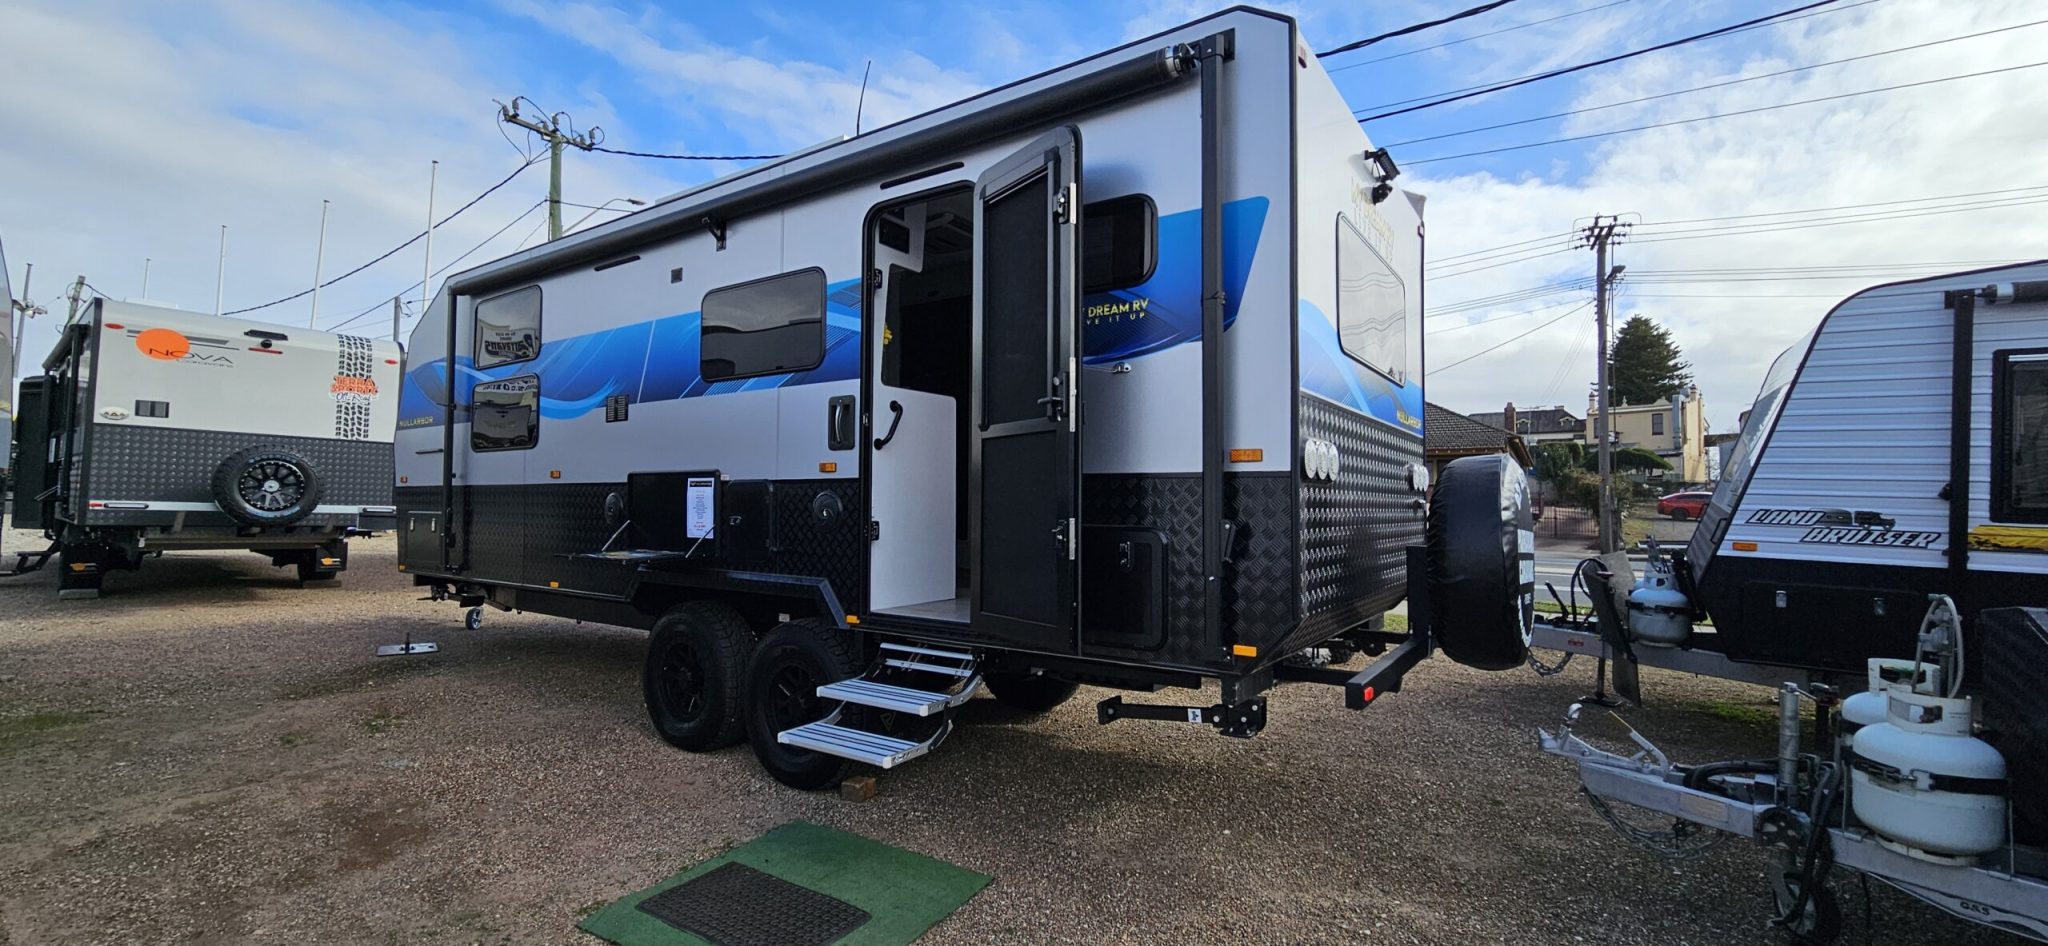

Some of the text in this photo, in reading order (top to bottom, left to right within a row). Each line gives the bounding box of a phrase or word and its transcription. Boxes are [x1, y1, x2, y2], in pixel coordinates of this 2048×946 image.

[1088, 303, 1129, 317] DREAM
[1132, 298, 1149, 312] RV
[1108, 315, 1120, 323] IT
[1130, 311, 1146, 320] UP
[149, 348, 233, 364] NOVA
[335, 376, 376, 389] TERRA
[1745, 509, 1827, 525] LAND
[1799, 526, 1943, 549] BRUISER
